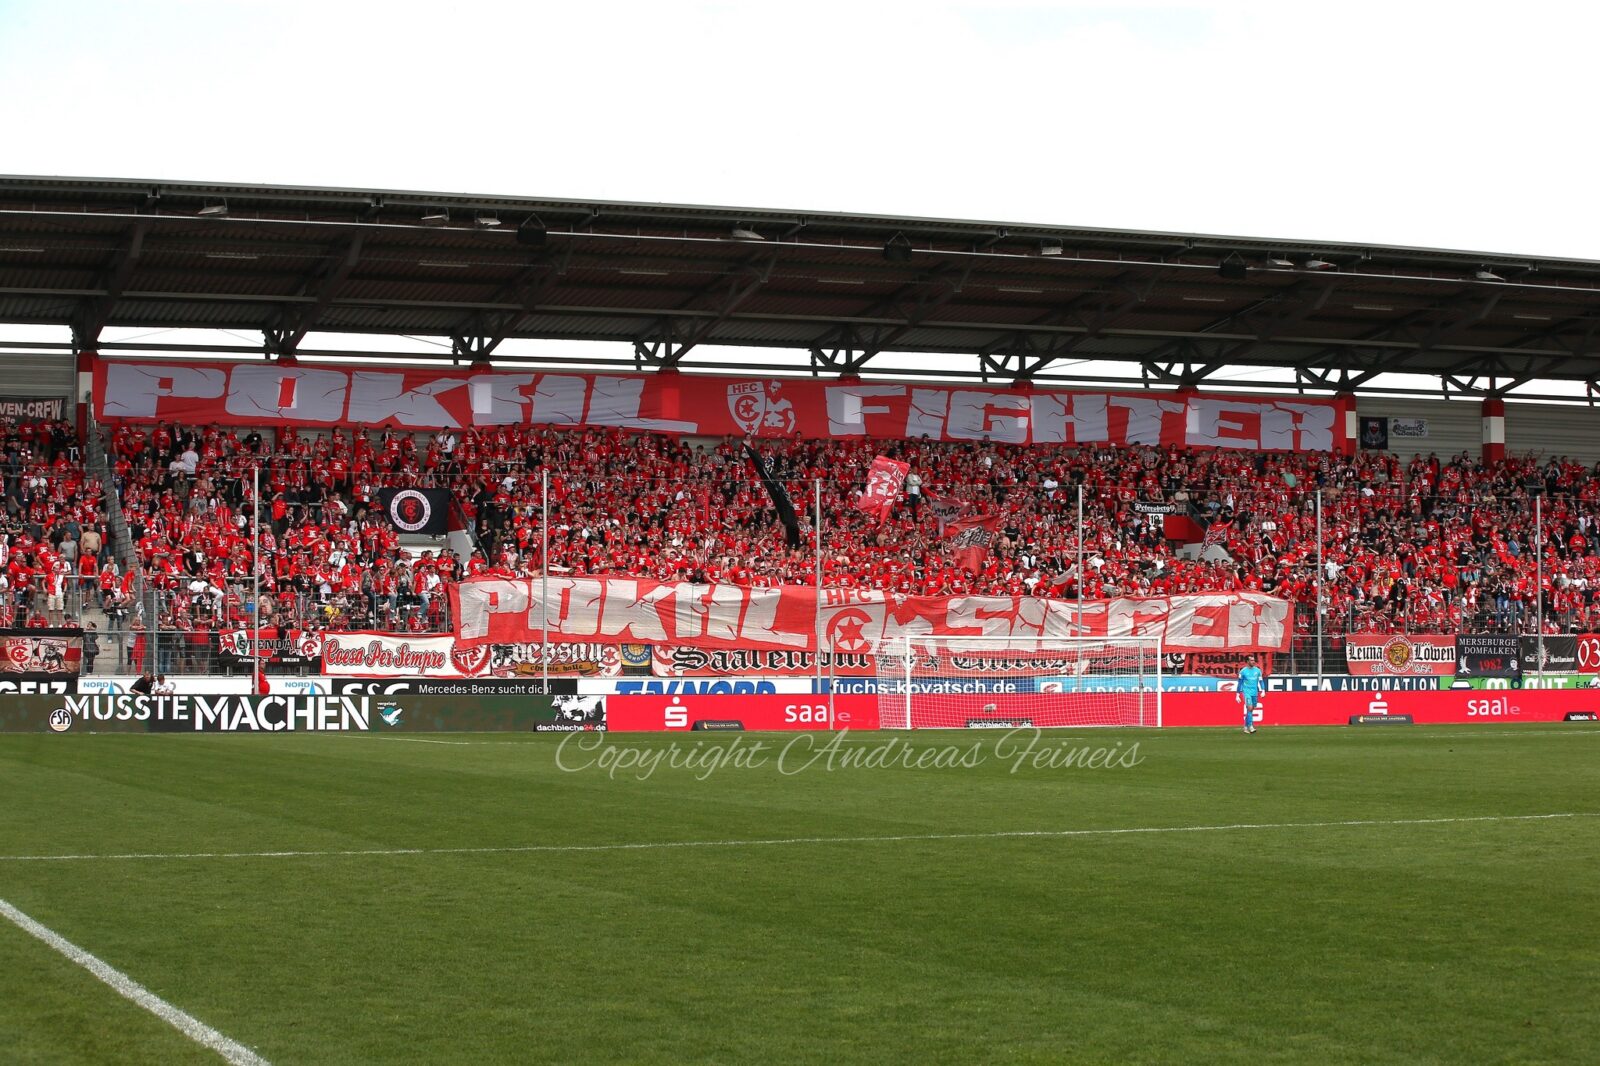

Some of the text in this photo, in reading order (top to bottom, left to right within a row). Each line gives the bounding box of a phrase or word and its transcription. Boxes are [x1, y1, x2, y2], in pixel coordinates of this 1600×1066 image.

[732, 383, 757, 393] HFC
[102, 363, 1337, 452] POKAL FIGHTER
[827, 588, 873, 605] HFC
[458, 577, 808, 648] POKAL
[366, 640, 395, 667] Per
[395, 643, 446, 674] Sempre
[1348, 642, 1455, 660] Leuna Löwen
[1464, 647, 1517, 655] DOMFALKEN
[1480, 658, 1503, 671] 1982
[419, 684, 495, 695] Mercedes-Benz
[498, 685, 526, 695] sucht
[833, 679, 1016, 694] fuchs-kovatsch.de
[1340, 679, 1437, 692] AUTOMATION
[51, 710, 70, 724] FSA
[64, 695, 369, 731] MUSSTE MACHEN
